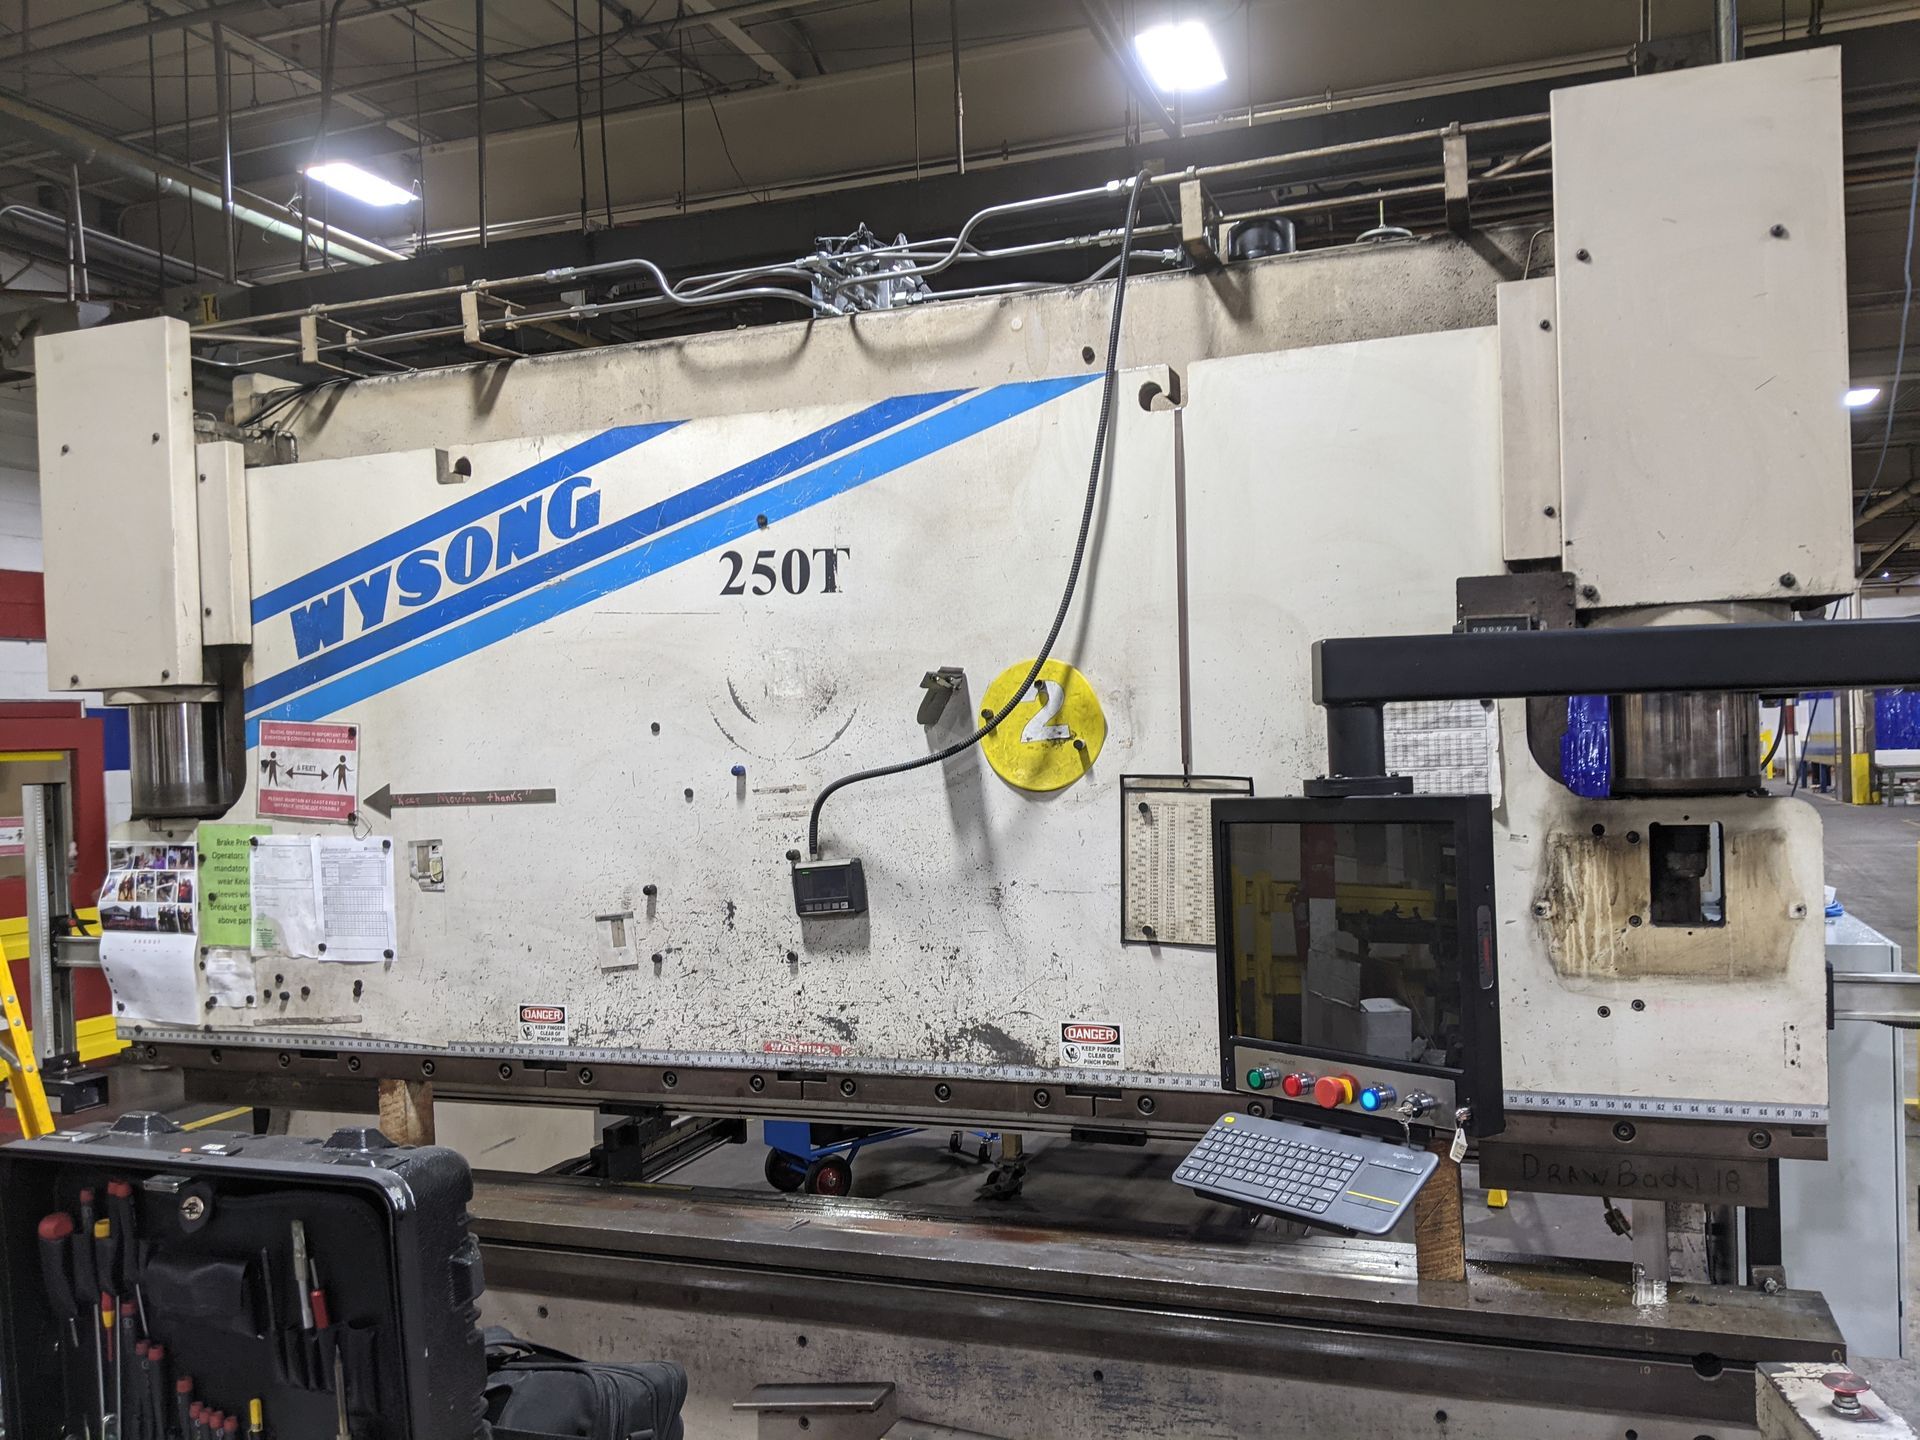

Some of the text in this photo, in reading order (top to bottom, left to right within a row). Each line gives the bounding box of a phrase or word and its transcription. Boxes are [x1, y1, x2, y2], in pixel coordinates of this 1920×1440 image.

[290, 476, 600, 660] WYSONG
[719, 547, 850, 596] 250T
[1020, 680, 1070, 743] 2
[211, 904, 237, 912] breaking
[525, 1010, 560, 1020] DANGER
[1068, 1028, 1114, 1040] DANGER
